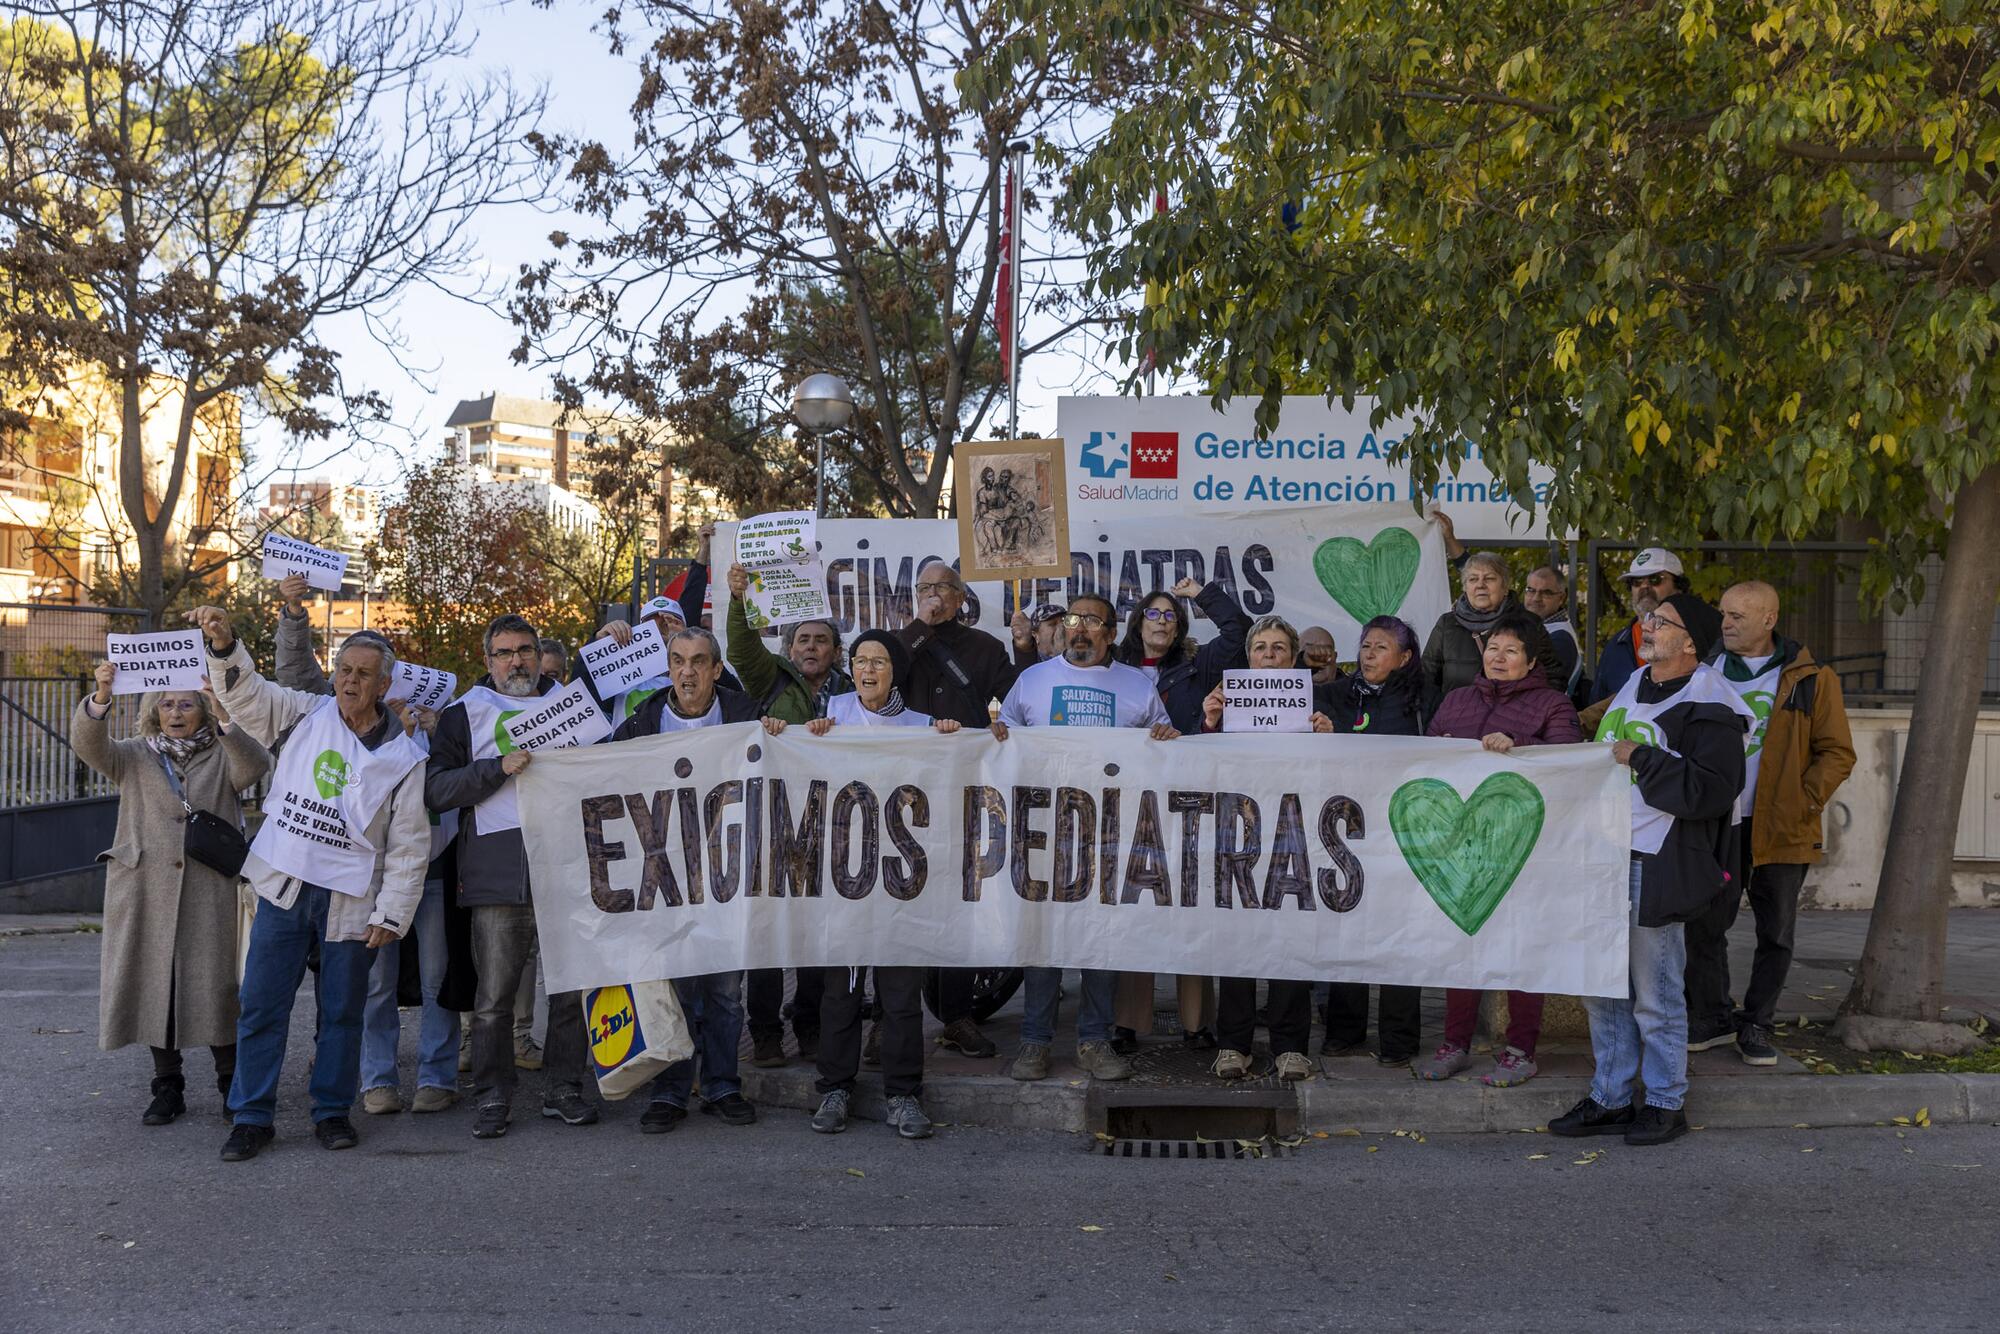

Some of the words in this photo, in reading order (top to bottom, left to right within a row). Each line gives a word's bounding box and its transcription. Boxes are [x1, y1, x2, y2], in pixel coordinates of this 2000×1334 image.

[1194, 432, 1345, 459] Gerencia
[1193, 475, 1234, 501] de
[1244, 475, 1396, 502] Atención
[753, 521, 774, 529] UN/A
[777, 517, 810, 527] NIÑO/A
[740, 532, 756, 540] SIN
[758, 528, 800, 538] PEDIATRA
[268, 536, 340, 562] EXIGIMOS
[755, 540, 766, 548] SU
[264, 547, 339, 571] PEDIATRAS
[741, 549, 776, 559] CENTRO
[756, 558, 783, 567] SALUD
[110, 639, 194, 654] EXIGIMOS
[591, 643, 660, 680] PEDIATRAS
[143, 675, 171, 687] ¡YA!
[621, 667, 643, 685] ¡YA!
[1226, 678, 1304, 690] EXIGIMOS
[1062, 688, 1112, 705] SALVEMOS
[1224, 697, 1307, 708] PEDIATRAS
[510, 691, 583, 738] EXIGIMOS
[1067, 701, 1112, 717] NUESTRA
[1067, 714, 1112, 728] SANIDAD
[1253, 714, 1278, 727] ¡YA!
[518, 706, 595, 752] PEDIATRAS
[284, 791, 298, 805] LA
[293, 812, 310, 826] SE
